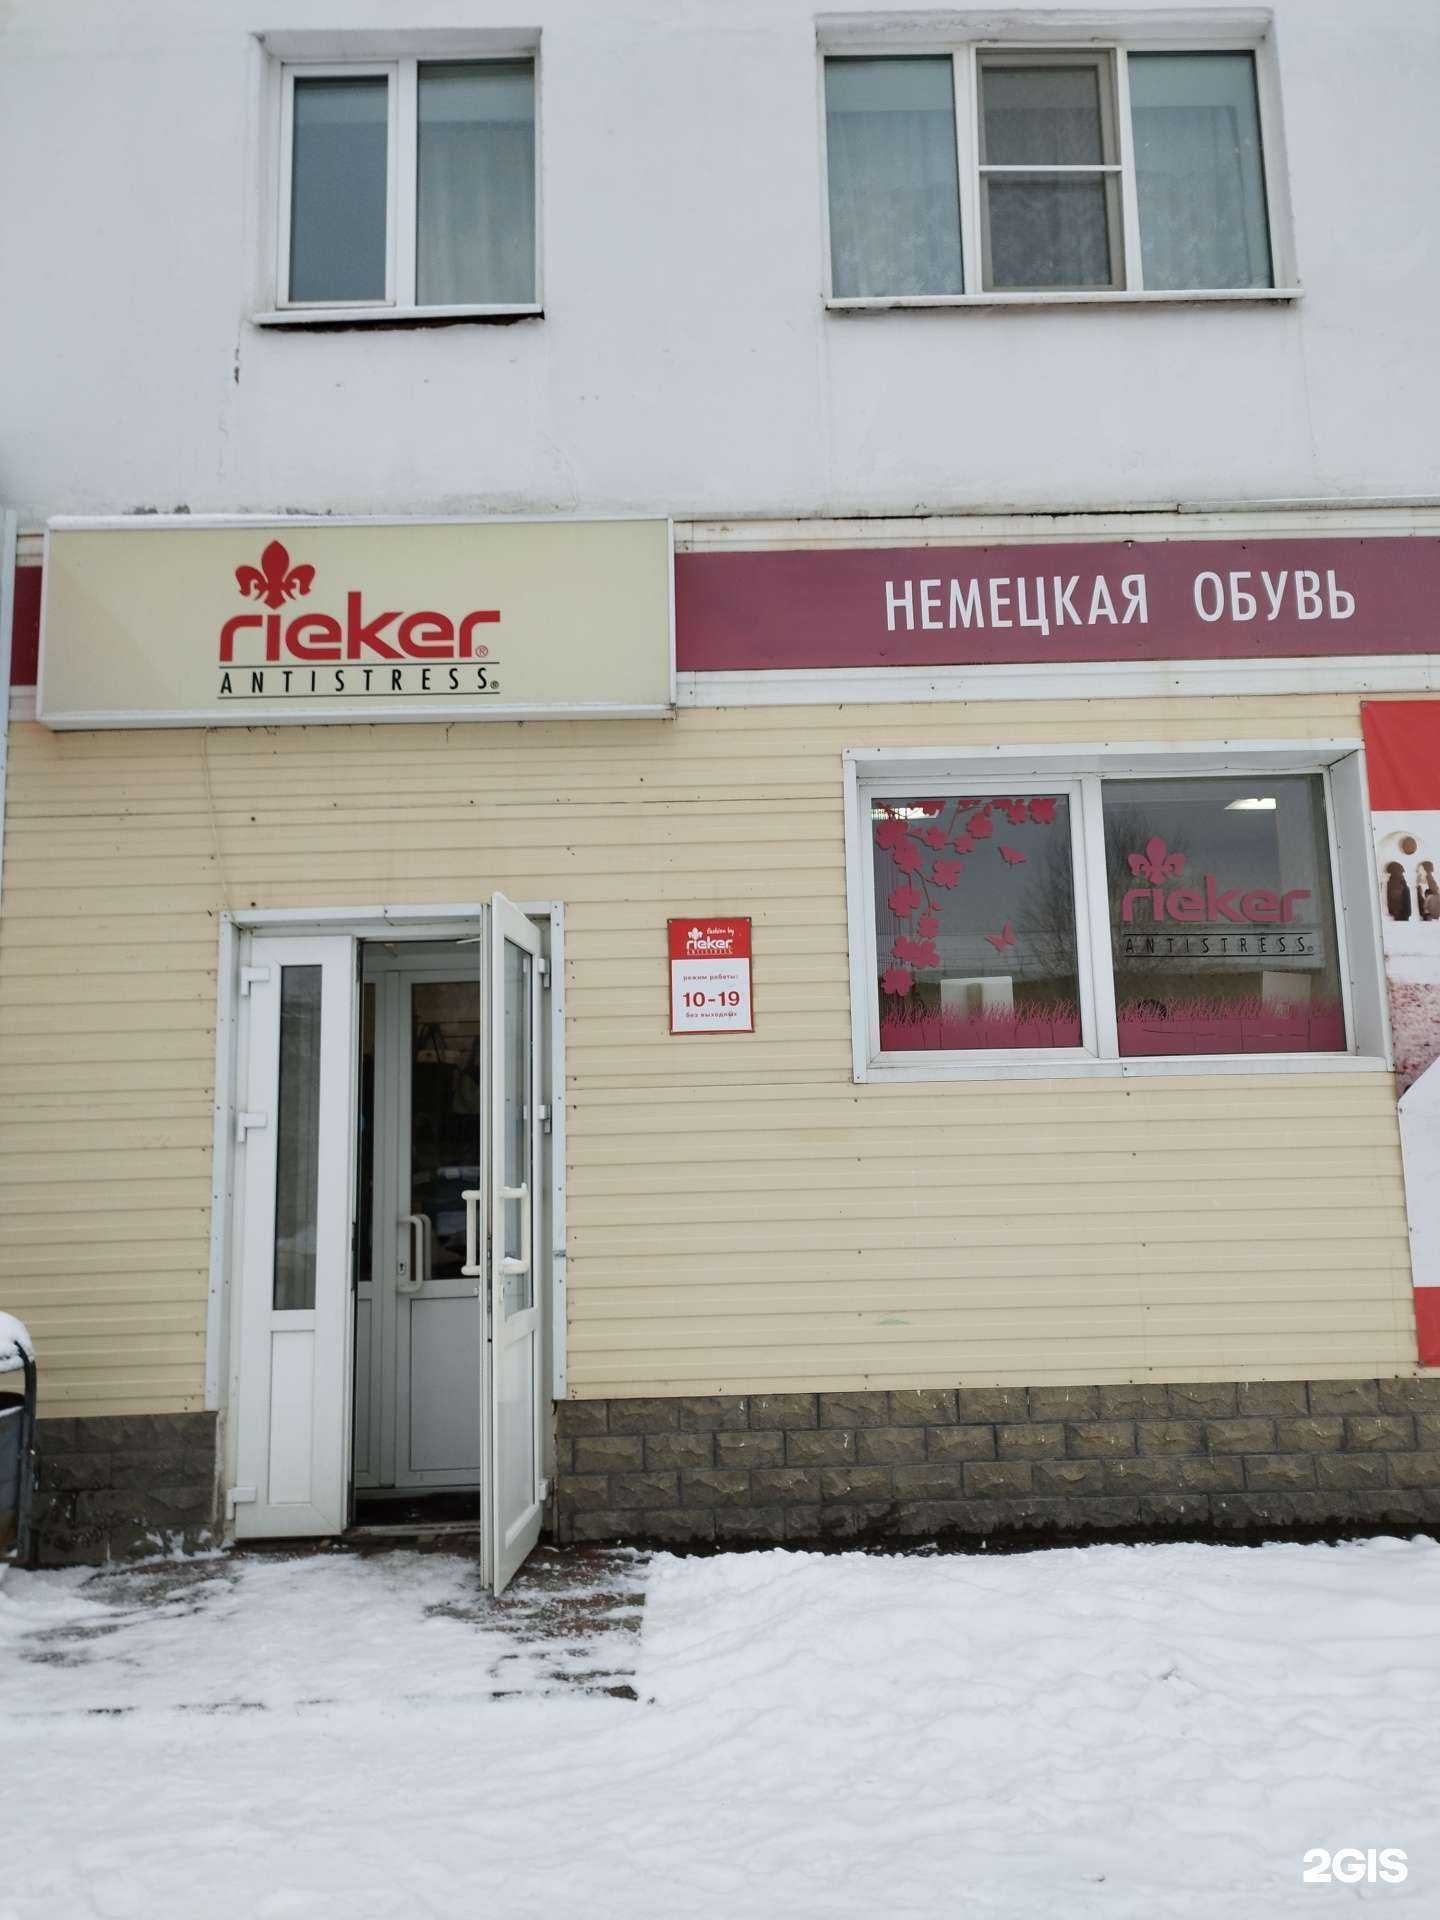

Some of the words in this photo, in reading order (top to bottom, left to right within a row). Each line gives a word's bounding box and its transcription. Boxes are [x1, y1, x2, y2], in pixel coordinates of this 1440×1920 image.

[885, 574, 1149, 636] НЕМЕЦКАЯ
[1194, 570, 1356, 623] ОБУВЬ
[219, 591, 501, 662] rieker
[220, 667, 488, 694] ANTISTRESS
[1121, 874, 1312, 923] rieker
[686, 935, 733, 949] rieker
[1125, 936, 1306, 954] ANTISTRESS
[683, 991, 740, 1007] 10-19
